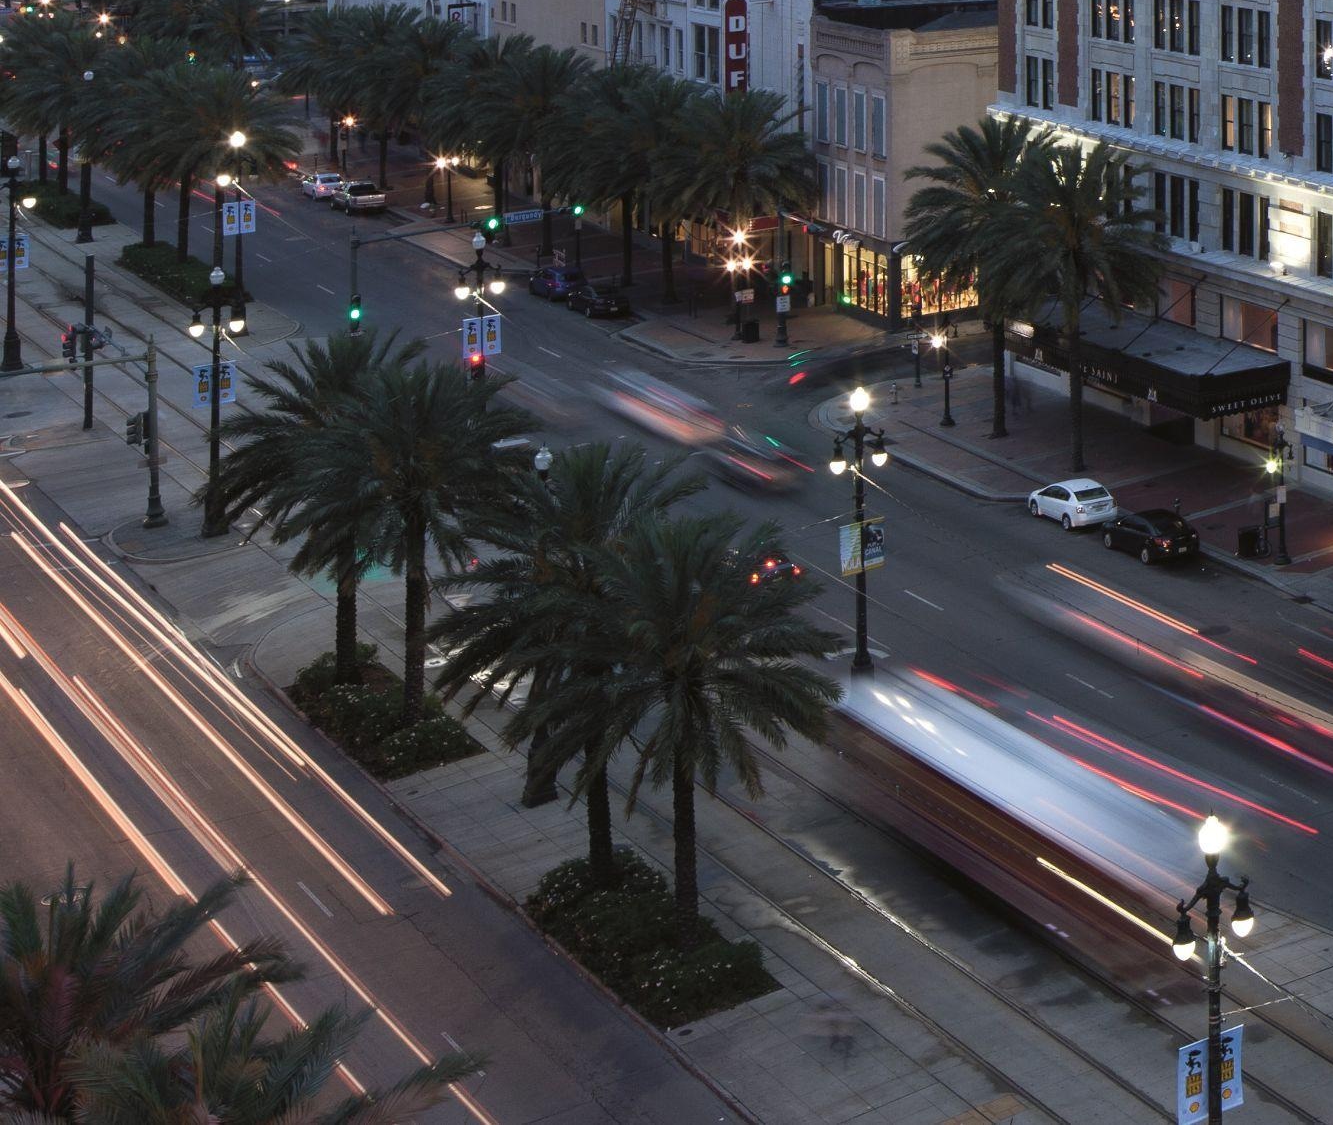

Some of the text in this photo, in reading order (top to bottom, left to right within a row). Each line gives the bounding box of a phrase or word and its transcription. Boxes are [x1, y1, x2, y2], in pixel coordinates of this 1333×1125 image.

[510, 210, 543, 222] Burgundy
[1211, 394, 1280, 413] SWEET OLIVE
[841, 557, 861, 572] NOLA
